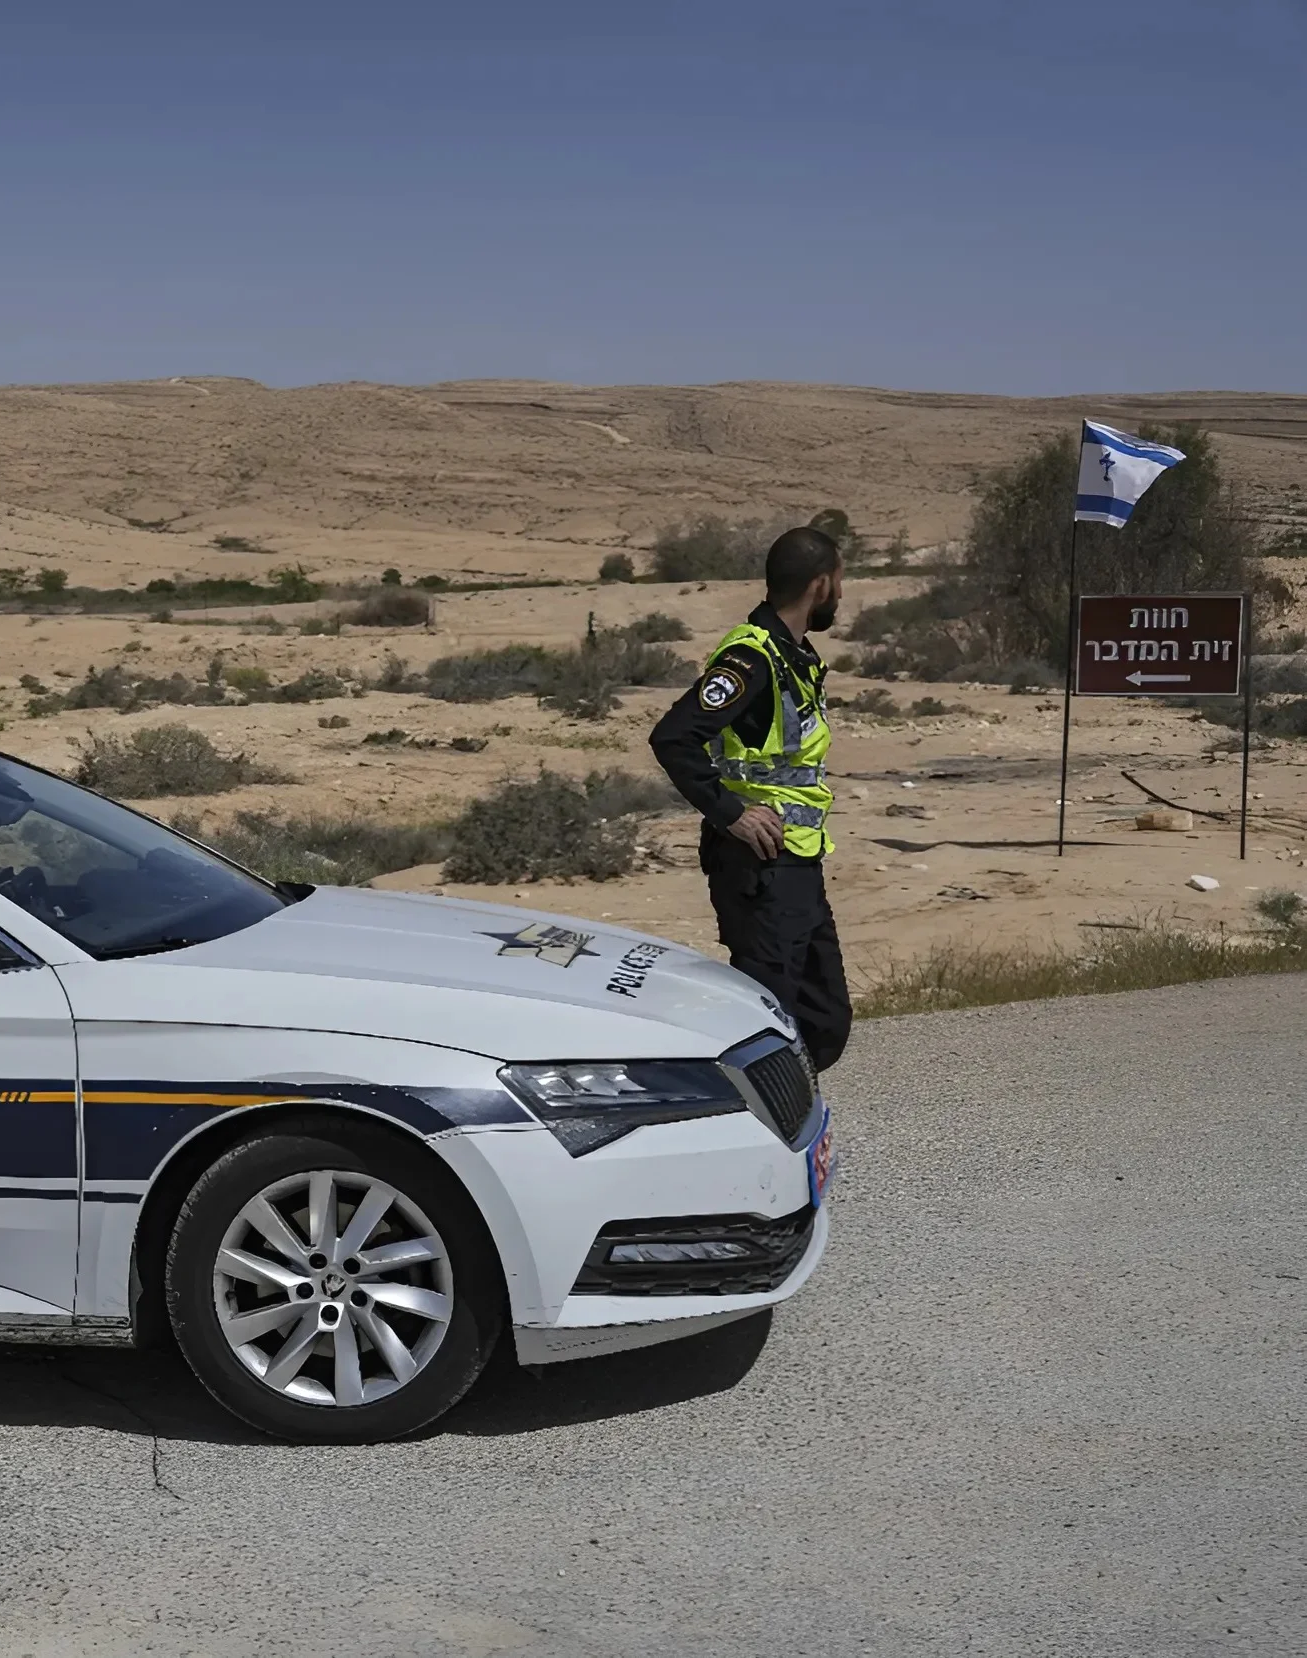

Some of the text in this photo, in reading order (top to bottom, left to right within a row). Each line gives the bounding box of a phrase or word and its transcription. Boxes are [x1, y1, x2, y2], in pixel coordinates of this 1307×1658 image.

[1129, 607, 1189, 629] חוות
[1085, 640, 1233, 662] זית המדבר
